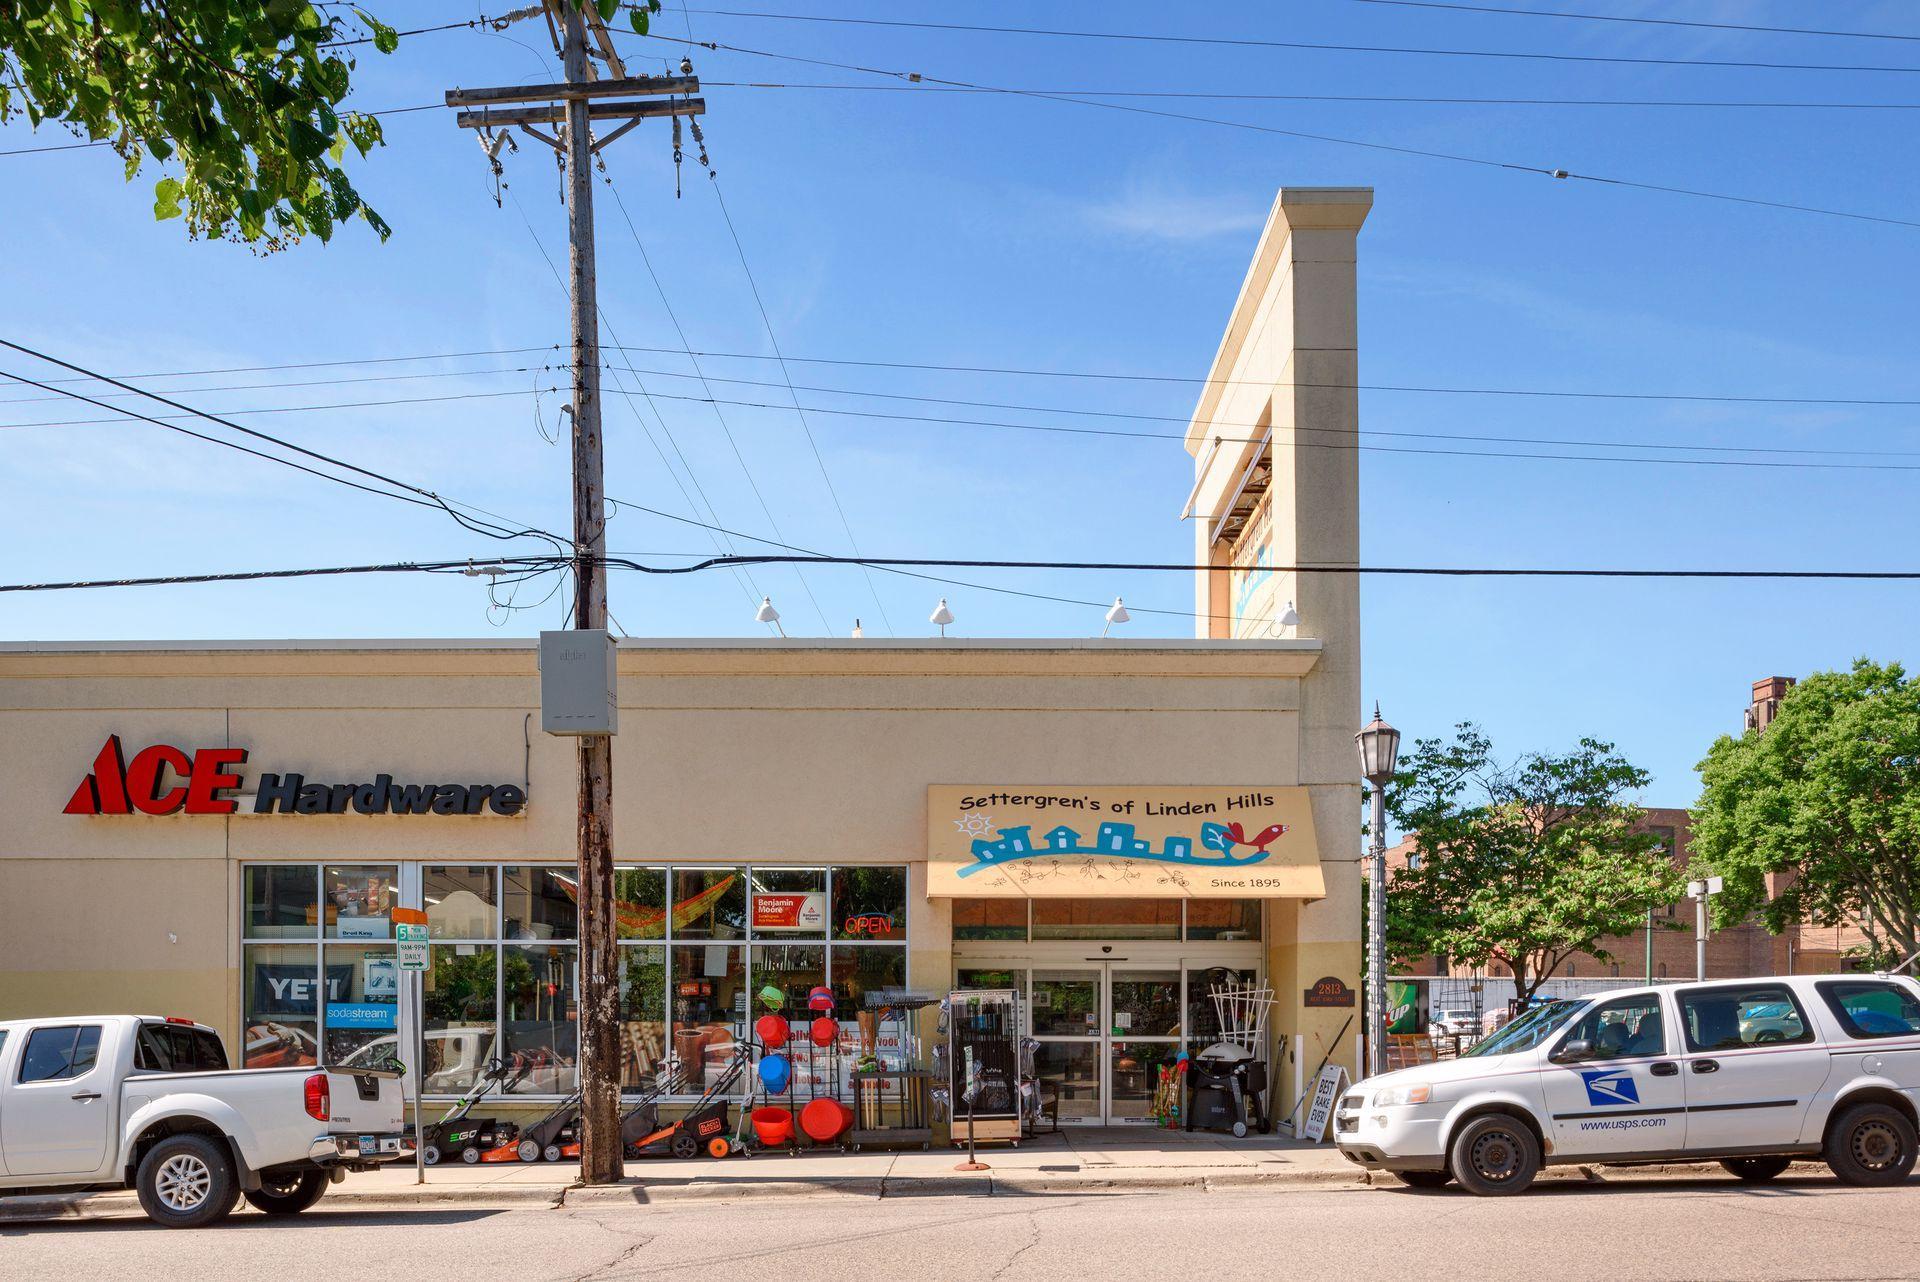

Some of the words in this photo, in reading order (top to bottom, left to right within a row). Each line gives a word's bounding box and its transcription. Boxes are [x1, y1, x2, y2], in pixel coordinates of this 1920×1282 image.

[62, 734, 249, 815] ACE
[254, 773, 525, 815] Hardware
[960, 793, 1101, 811] Settergren's
[1111, 800, 1134, 815] of
[1146, 800, 1217, 816] Linden
[1226, 793, 1275, 811] Hills
[1211, 879, 1246, 888] Since
[1249, 878, 1280, 888] 1895
[758, 899, 794, 909] Benjamin
[758, 906, 783, 914] Moore
[845, 917, 891, 934] OPEN
[400, 927, 407, 939] 5
[1318, 983, 1341, 995] 2813
[328, 1007, 388, 1018] sodastream
[1318, 1079, 1335, 1095] BEST
[1314, 1096, 1330, 1108] RAKE
[1581, 1118, 1667, 1131] www.usps.com
[450, 1129, 478, 1143] EGO
